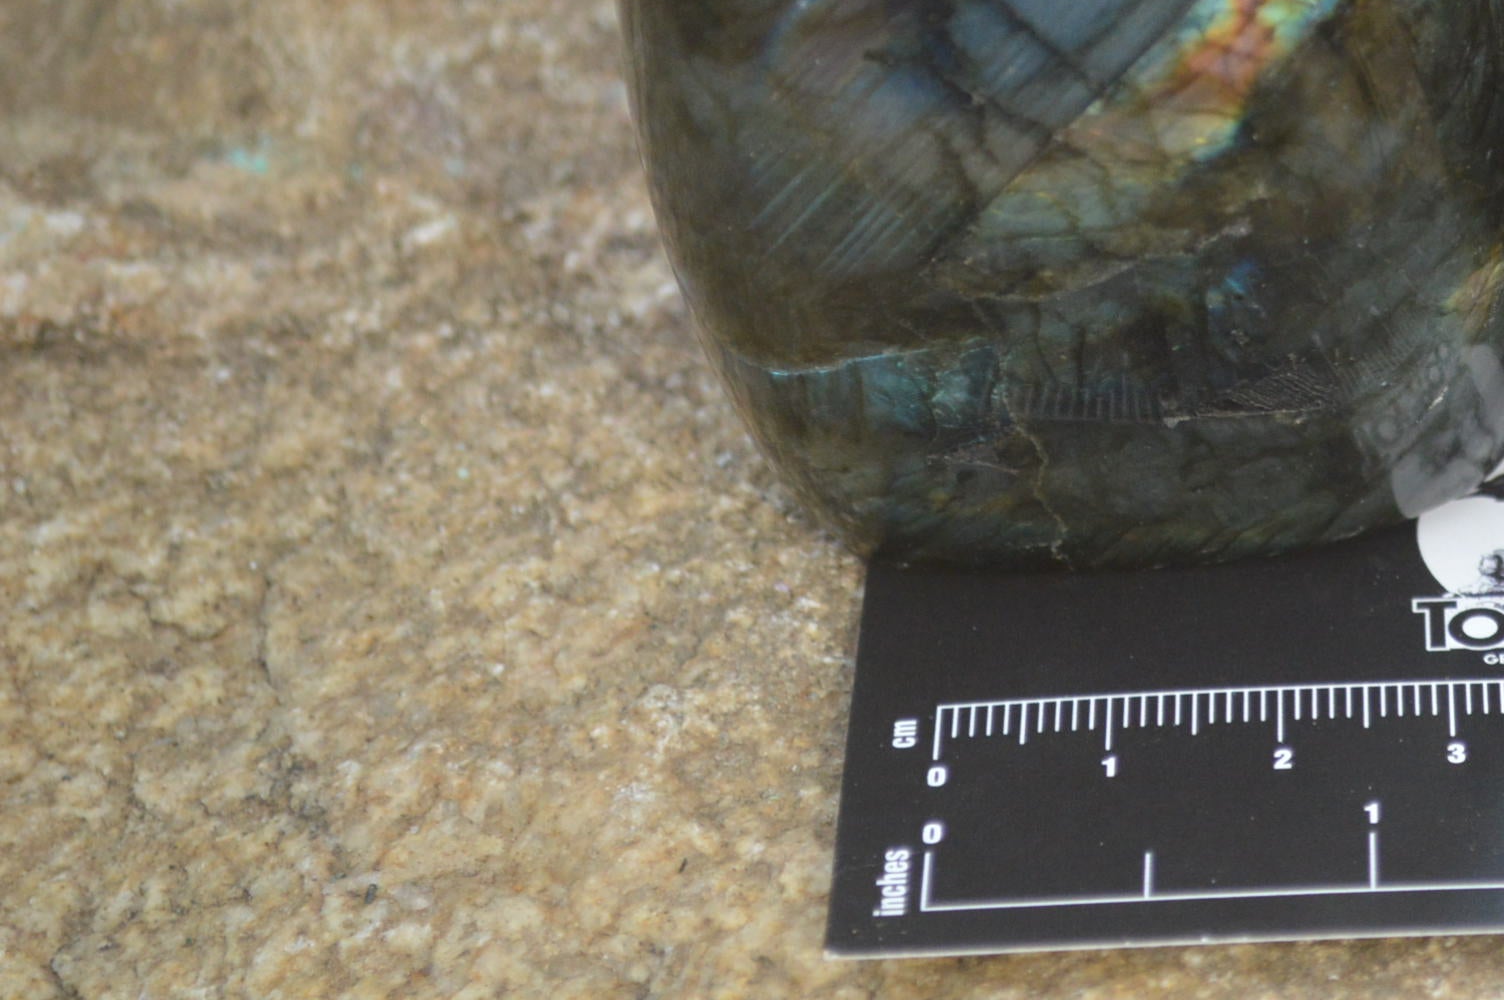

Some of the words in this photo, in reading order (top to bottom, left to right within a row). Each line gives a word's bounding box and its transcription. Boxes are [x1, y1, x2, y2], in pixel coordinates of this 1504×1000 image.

[892, 719, 917, 748] cm
[927, 766, 947, 787] 0
[1101, 756, 1116, 777] 1
[1273, 748, 1293, 769] 2
[1447, 742, 1466, 764] 3
[922, 822, 944, 844] 0
[1364, 802, 1379, 824] 1
[873, 848, 910, 917] inches
